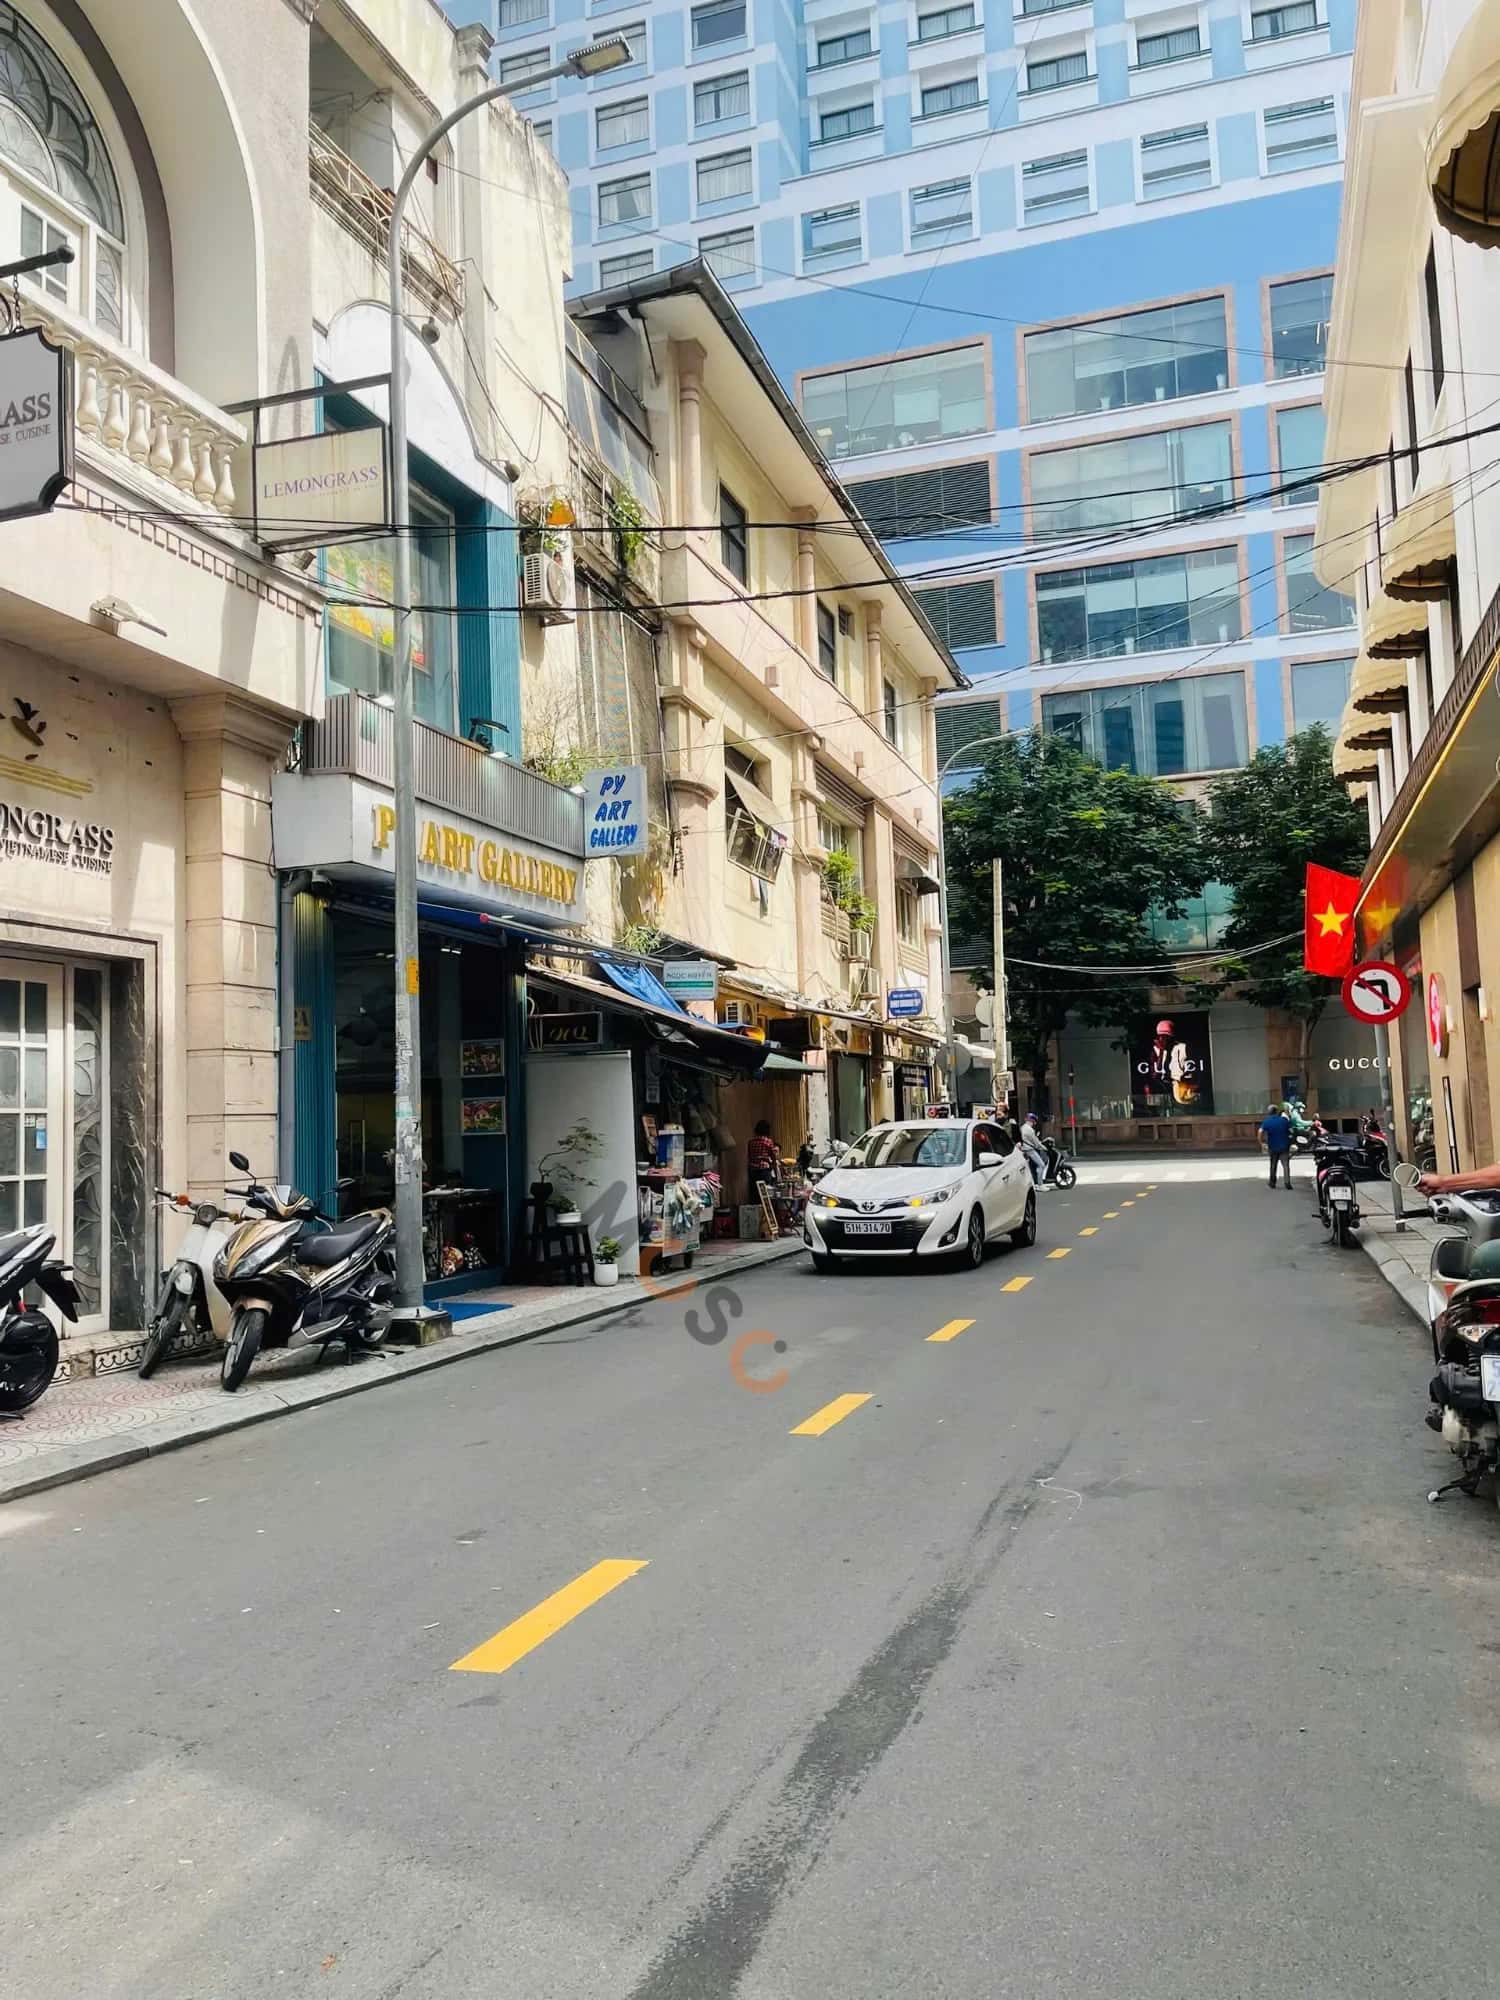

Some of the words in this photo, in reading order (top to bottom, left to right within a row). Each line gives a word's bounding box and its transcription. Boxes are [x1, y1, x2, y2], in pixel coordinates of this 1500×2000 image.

[0, 392, 51, 428] ASS
[263, 466, 379, 499] LEMONGRASS
[599, 774, 626, 796] PY
[594, 800, 632, 822] ART
[590, 824, 638, 849] GALLERY
[372, 804, 397, 849] P
[418, 820, 476, 874] ART
[477, 839, 578, 906] GALLERY
[1137, 1059, 1204, 1075] GUCI
